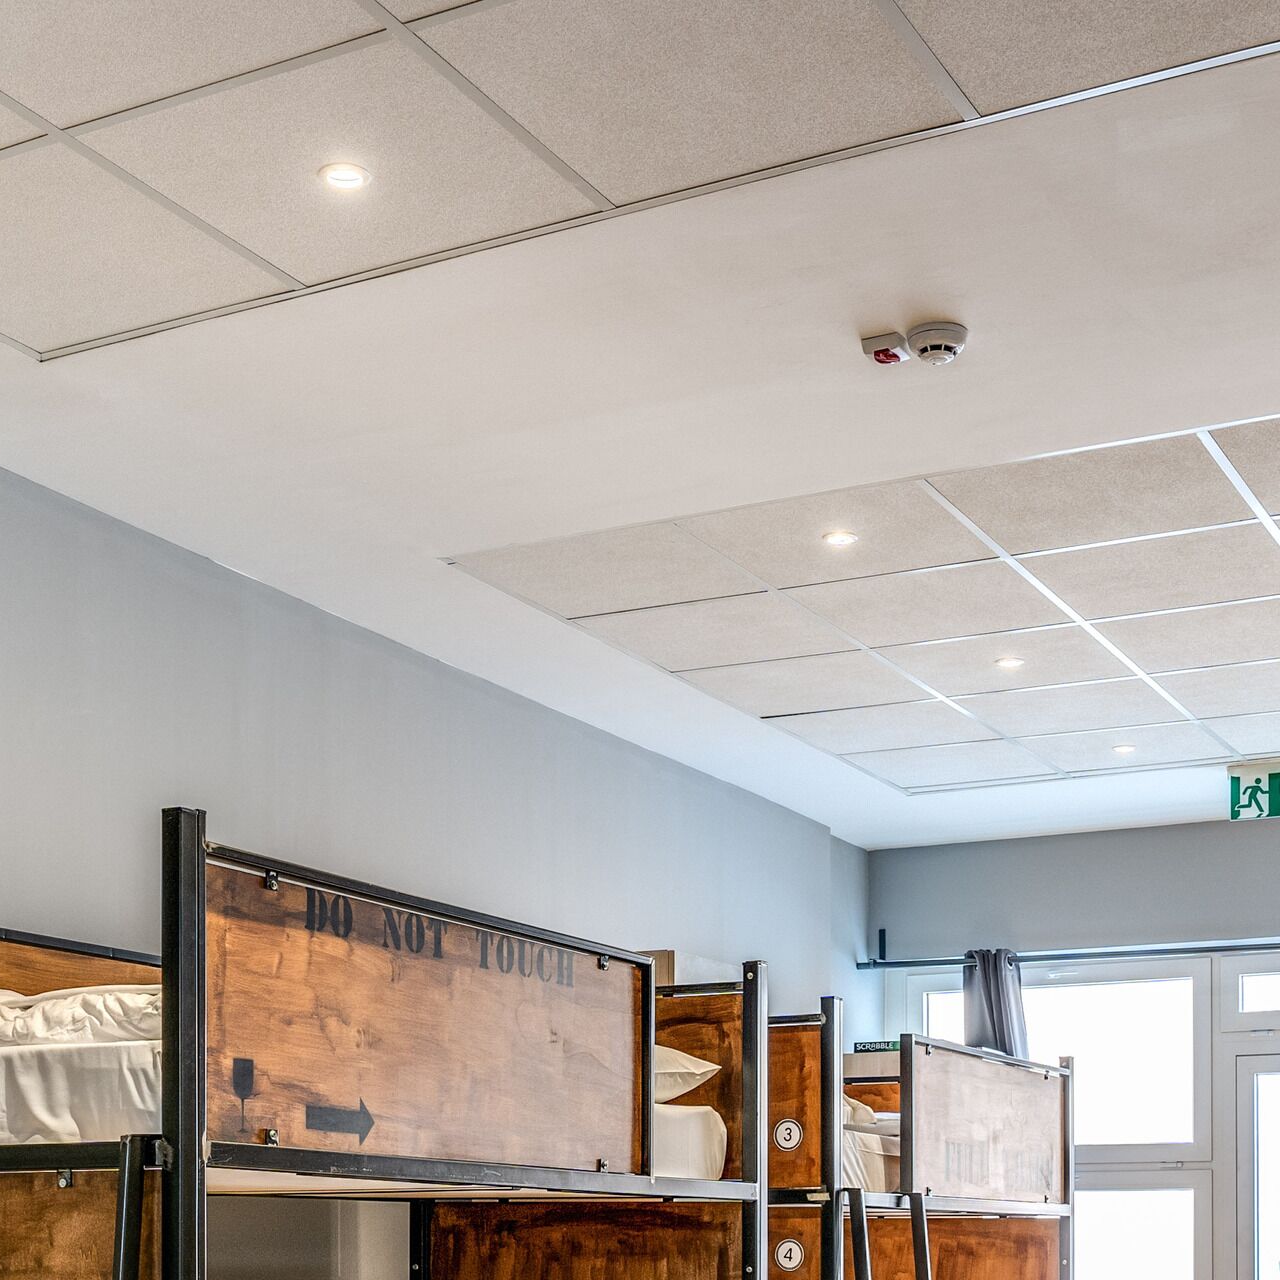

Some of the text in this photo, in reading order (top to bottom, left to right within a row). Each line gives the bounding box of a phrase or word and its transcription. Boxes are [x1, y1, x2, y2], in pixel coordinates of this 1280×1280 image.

[305, 887, 575, 988] DO NOT TOUCH
[856, 1042, 894, 1051] SCRABBLE
[783, 1127, 793, 1142] 3
[783, 1247, 793, 1262] 4
